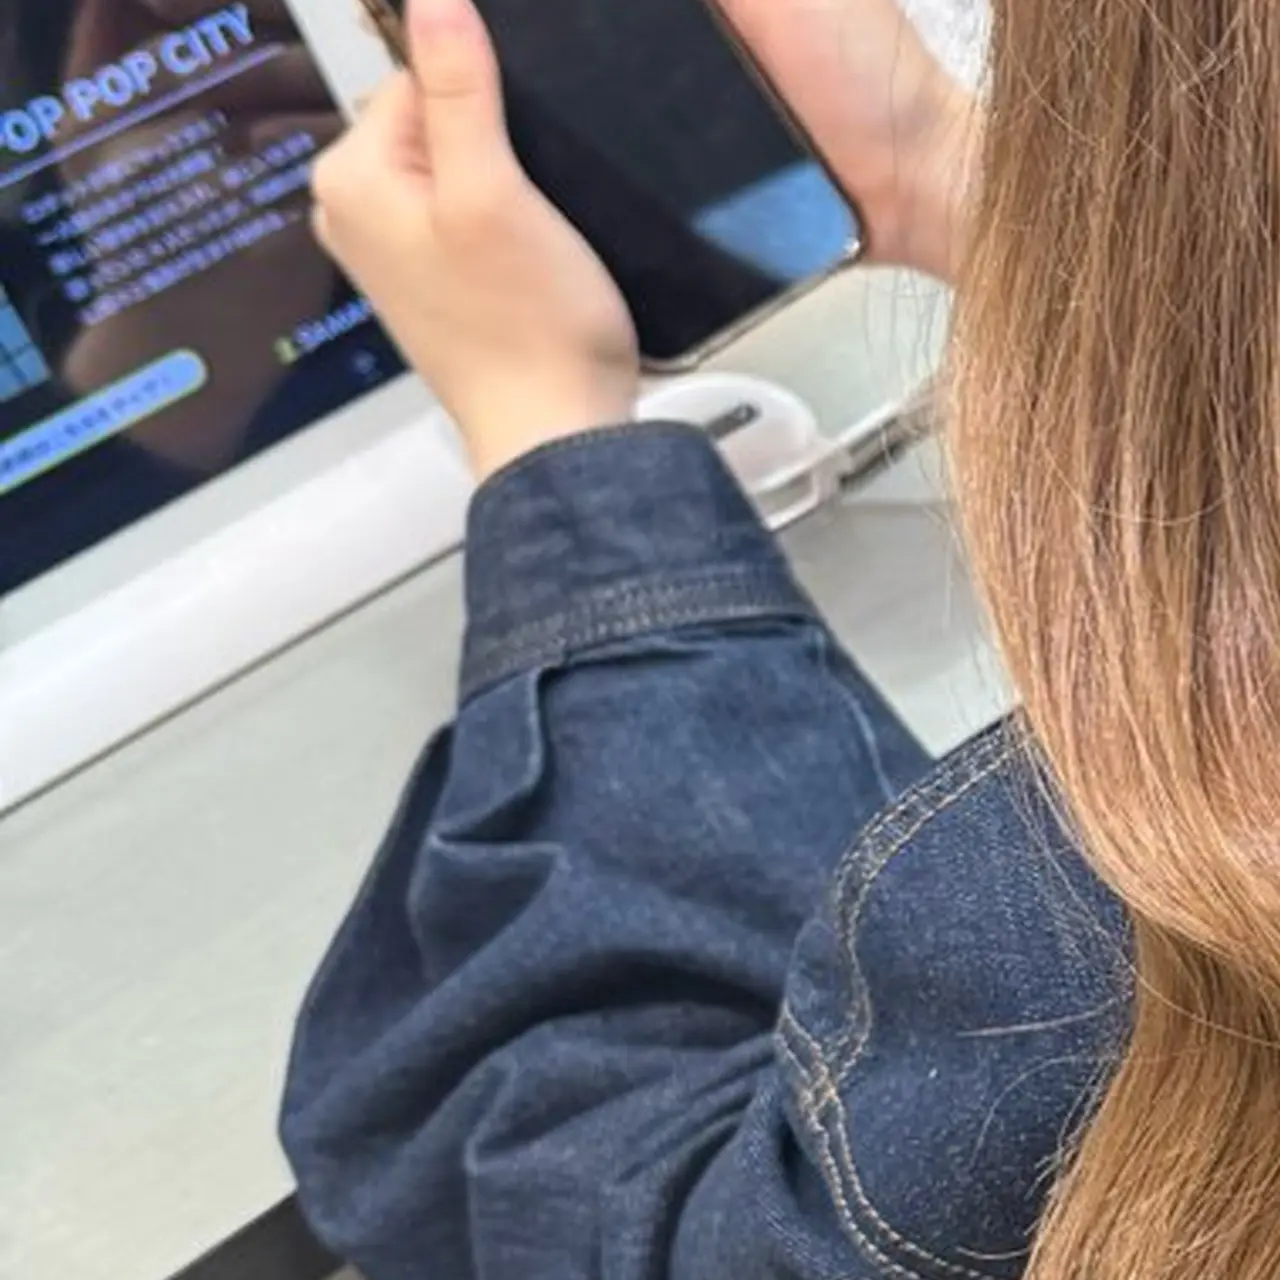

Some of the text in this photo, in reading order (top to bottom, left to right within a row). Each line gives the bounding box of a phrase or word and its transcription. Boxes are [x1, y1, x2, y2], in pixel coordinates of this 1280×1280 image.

[0, 2, 254, 152] OP POP CITY
